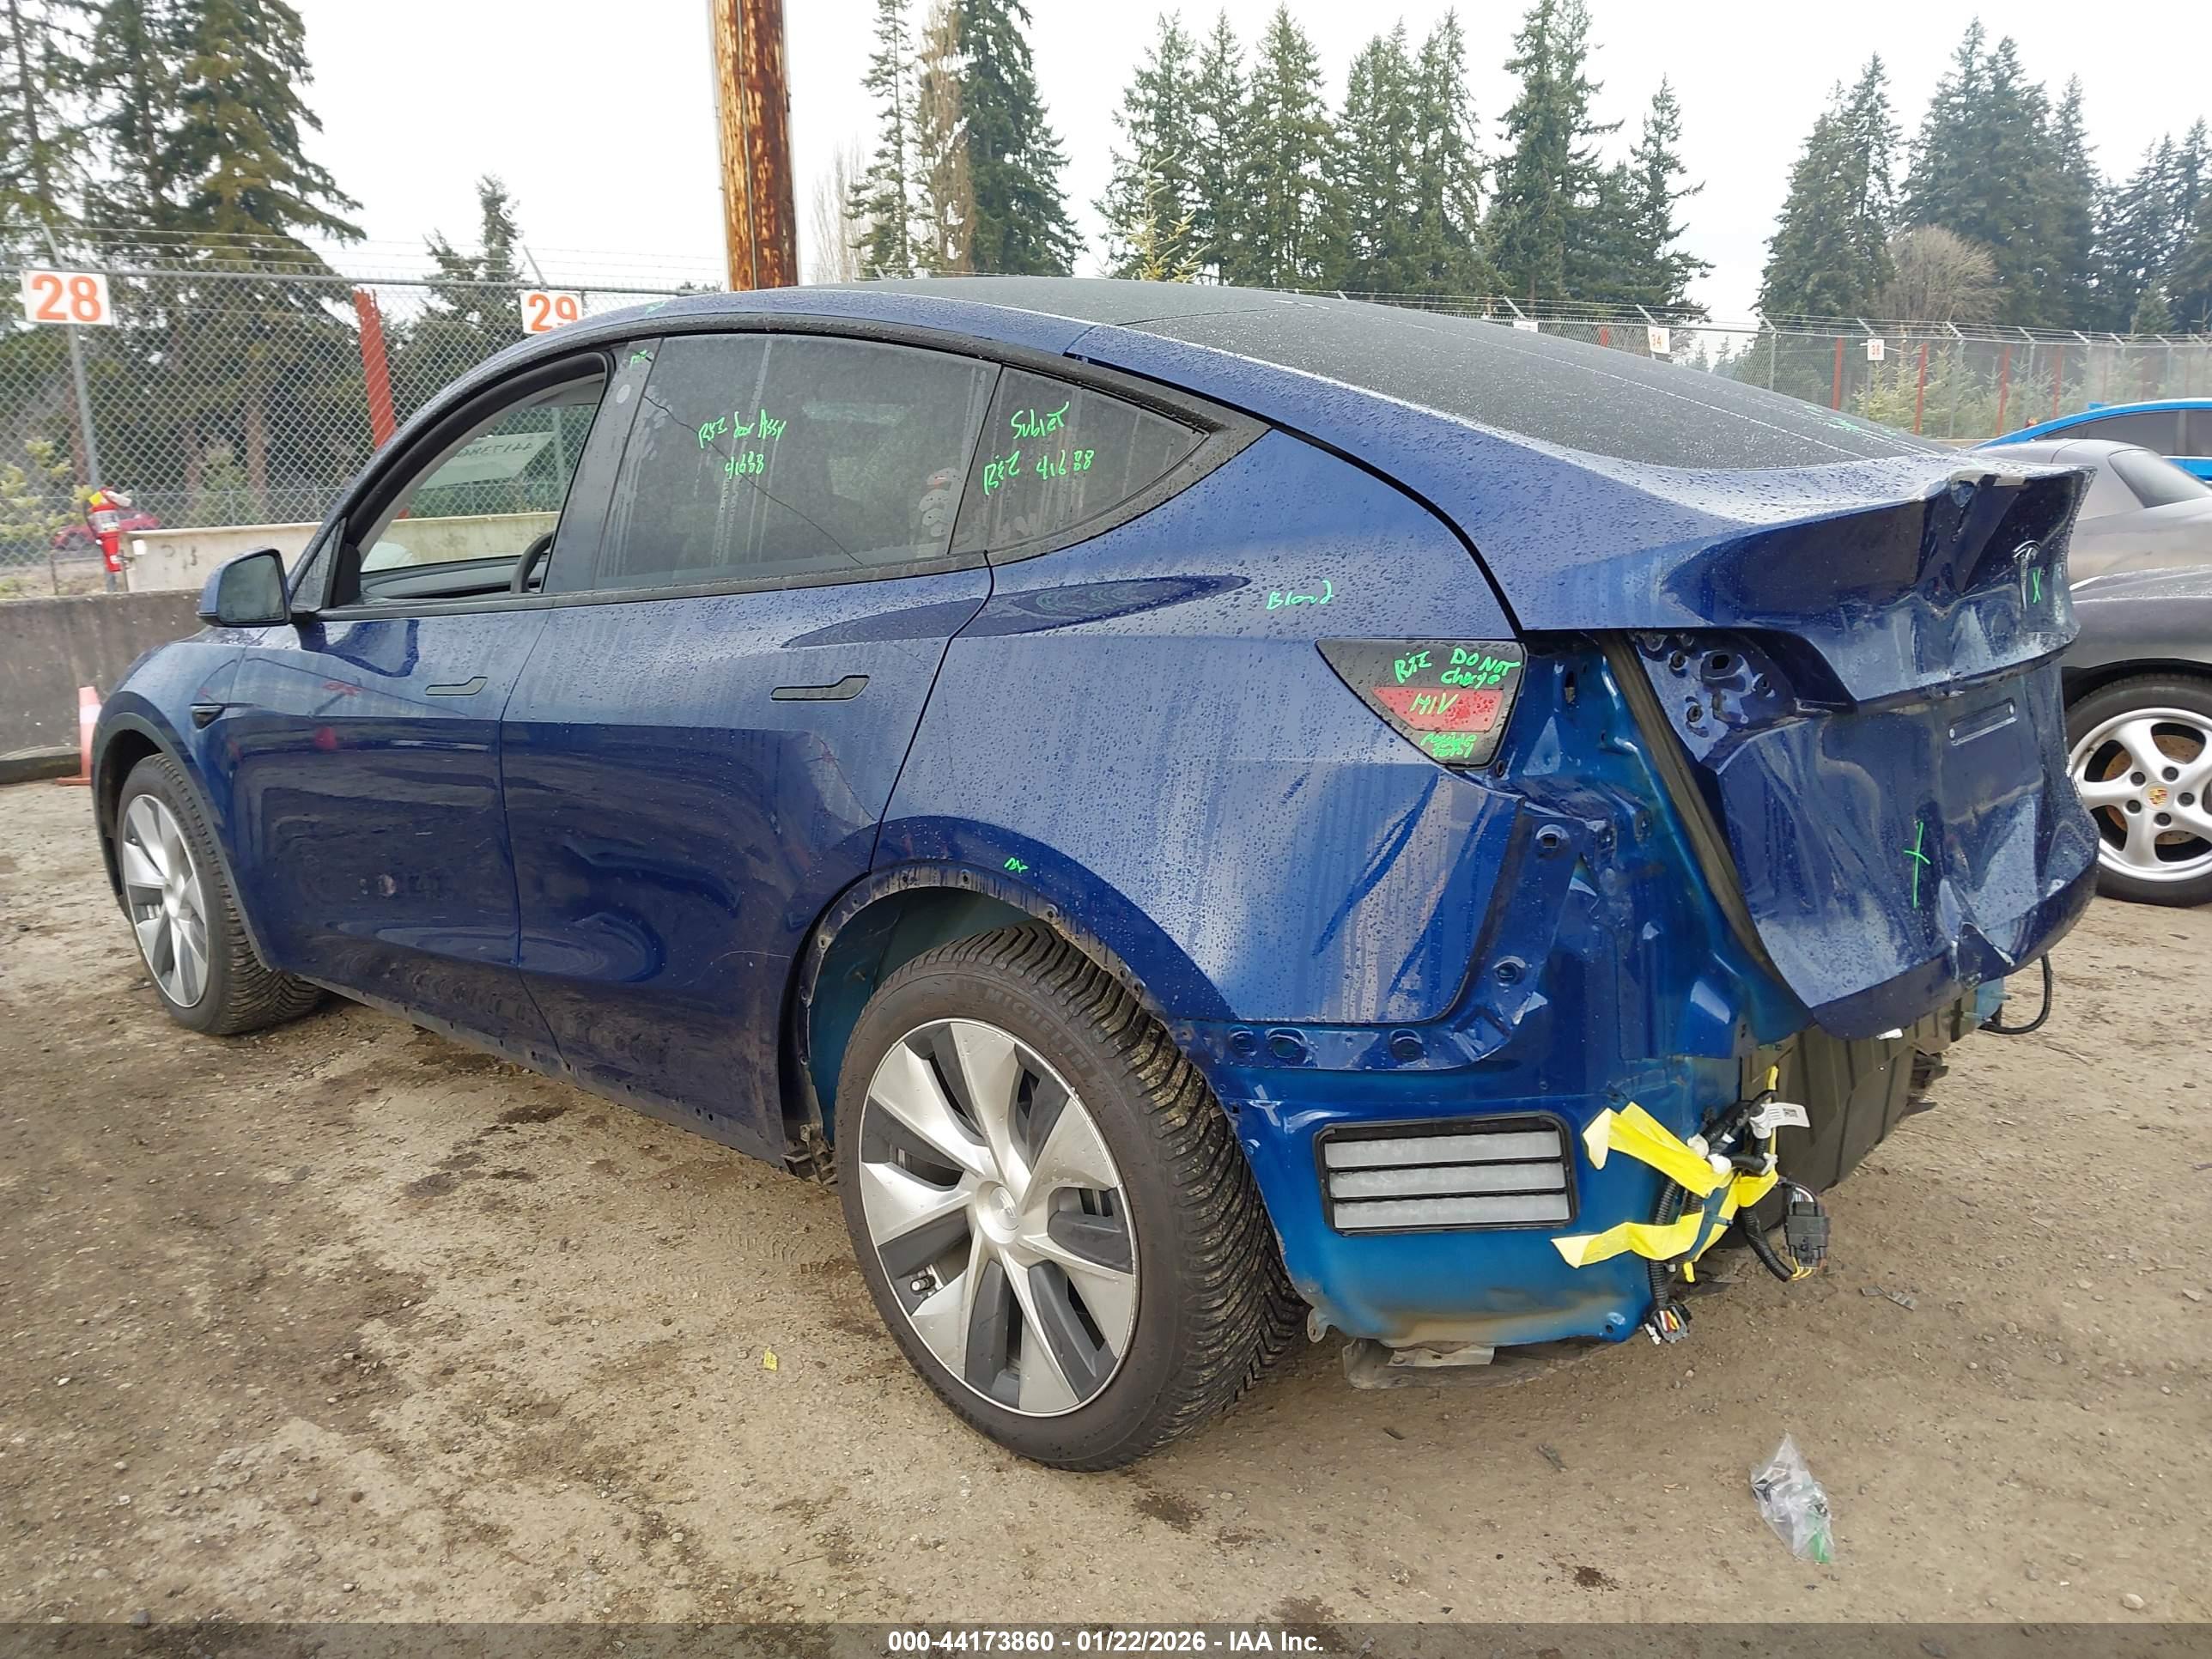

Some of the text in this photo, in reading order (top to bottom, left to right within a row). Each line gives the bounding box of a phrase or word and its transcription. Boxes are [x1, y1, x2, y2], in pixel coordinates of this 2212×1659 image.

[30, 274, 101, 322] 28
[527, 294, 577, 331] 29
[984, 988, 1088, 1068] MICHELIN
